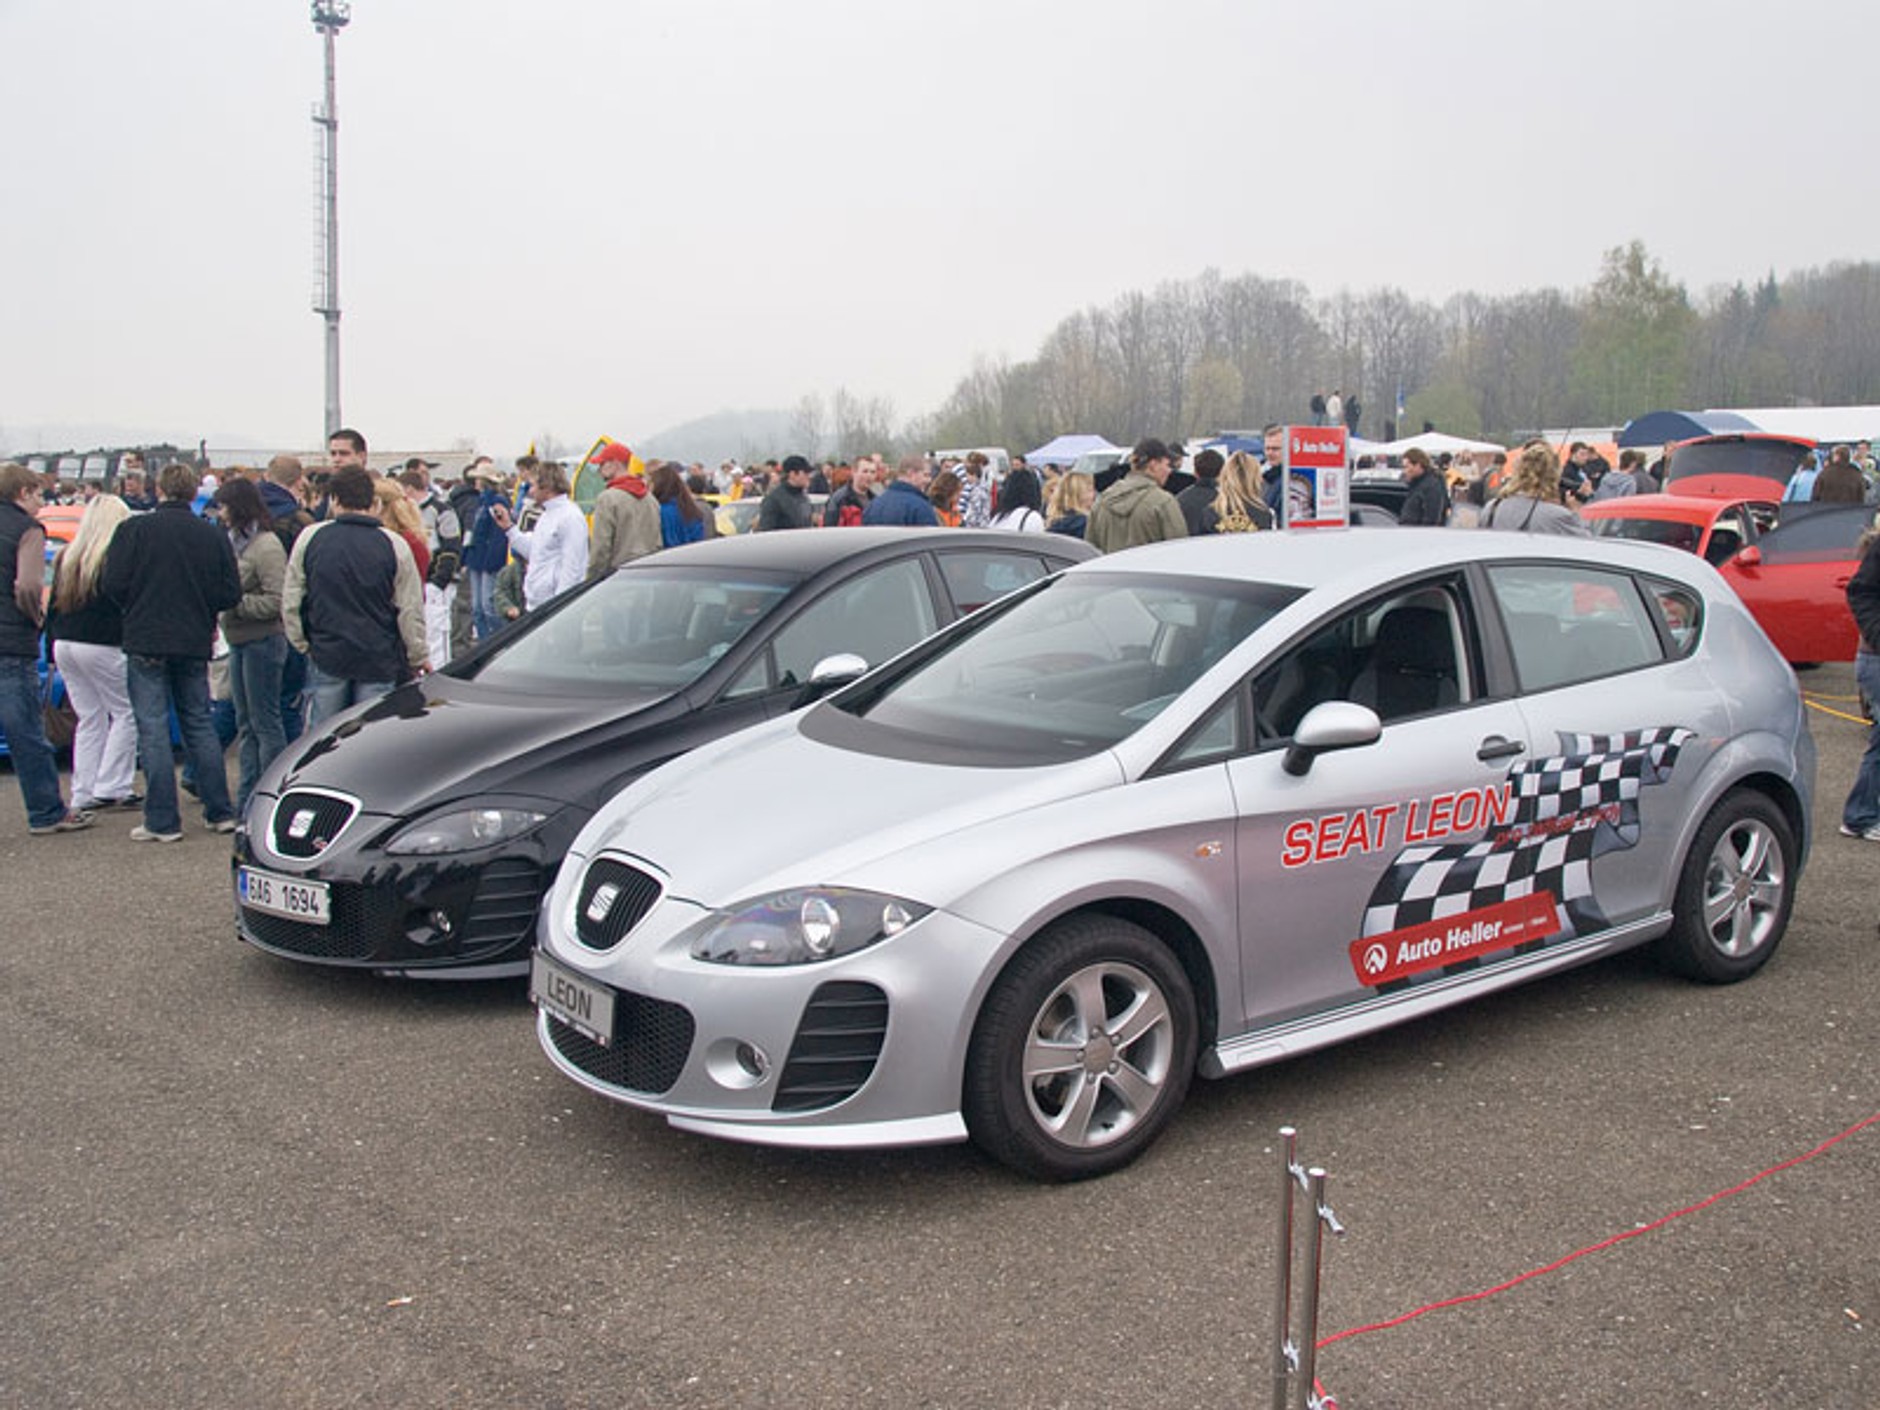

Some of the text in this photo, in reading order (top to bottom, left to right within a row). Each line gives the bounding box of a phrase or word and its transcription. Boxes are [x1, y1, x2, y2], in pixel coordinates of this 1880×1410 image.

[1282, 804, 1397, 869] SEAT
[1404, 782, 1512, 843] LEON
[282, 884, 319, 915] 1694
[1396, 920, 1502, 965] Auto Heller
[548, 972, 592, 1020] LEON
